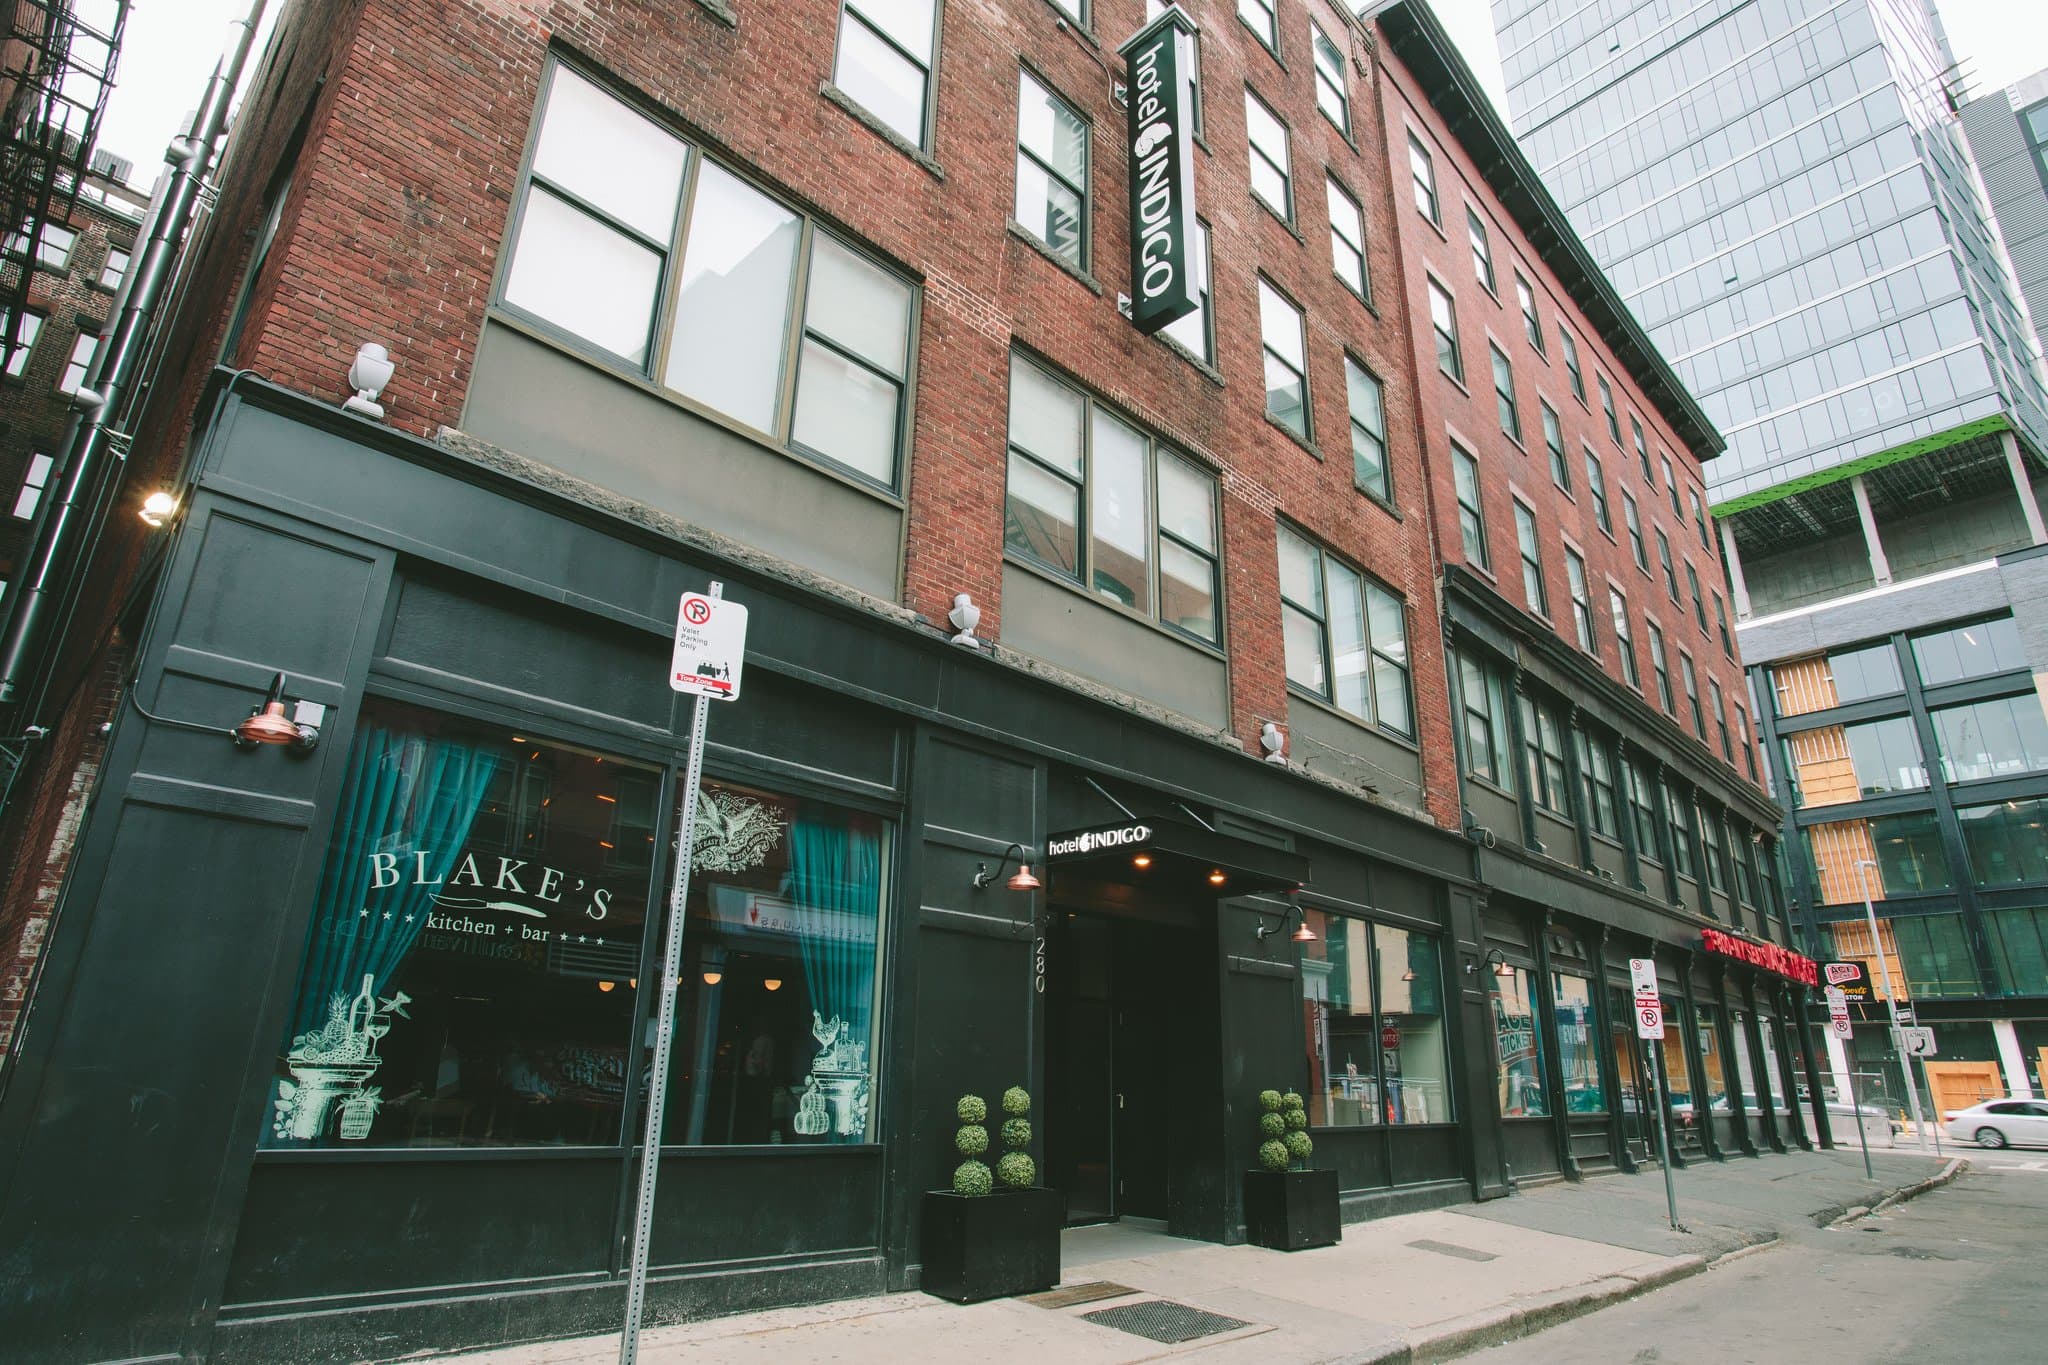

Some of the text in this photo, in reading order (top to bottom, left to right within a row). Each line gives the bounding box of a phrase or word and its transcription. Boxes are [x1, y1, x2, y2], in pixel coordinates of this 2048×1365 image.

[1136, 41, 1173, 299] hotel INDIGO
[680, 633, 708, 646] Parking
[682, 625, 700, 635] Valet
[680, 641, 697, 651] Only
[1049, 825, 1148, 856] hotel INDIGO
[368, 850, 613, 920] BLAKE'S
[425, 911, 550, 941] kitchen + bar
[1035, 937, 1046, 993] 280
[1496, 998, 1532, 1032] ACE
[1499, 1033, 1533, 1058] TICKET
